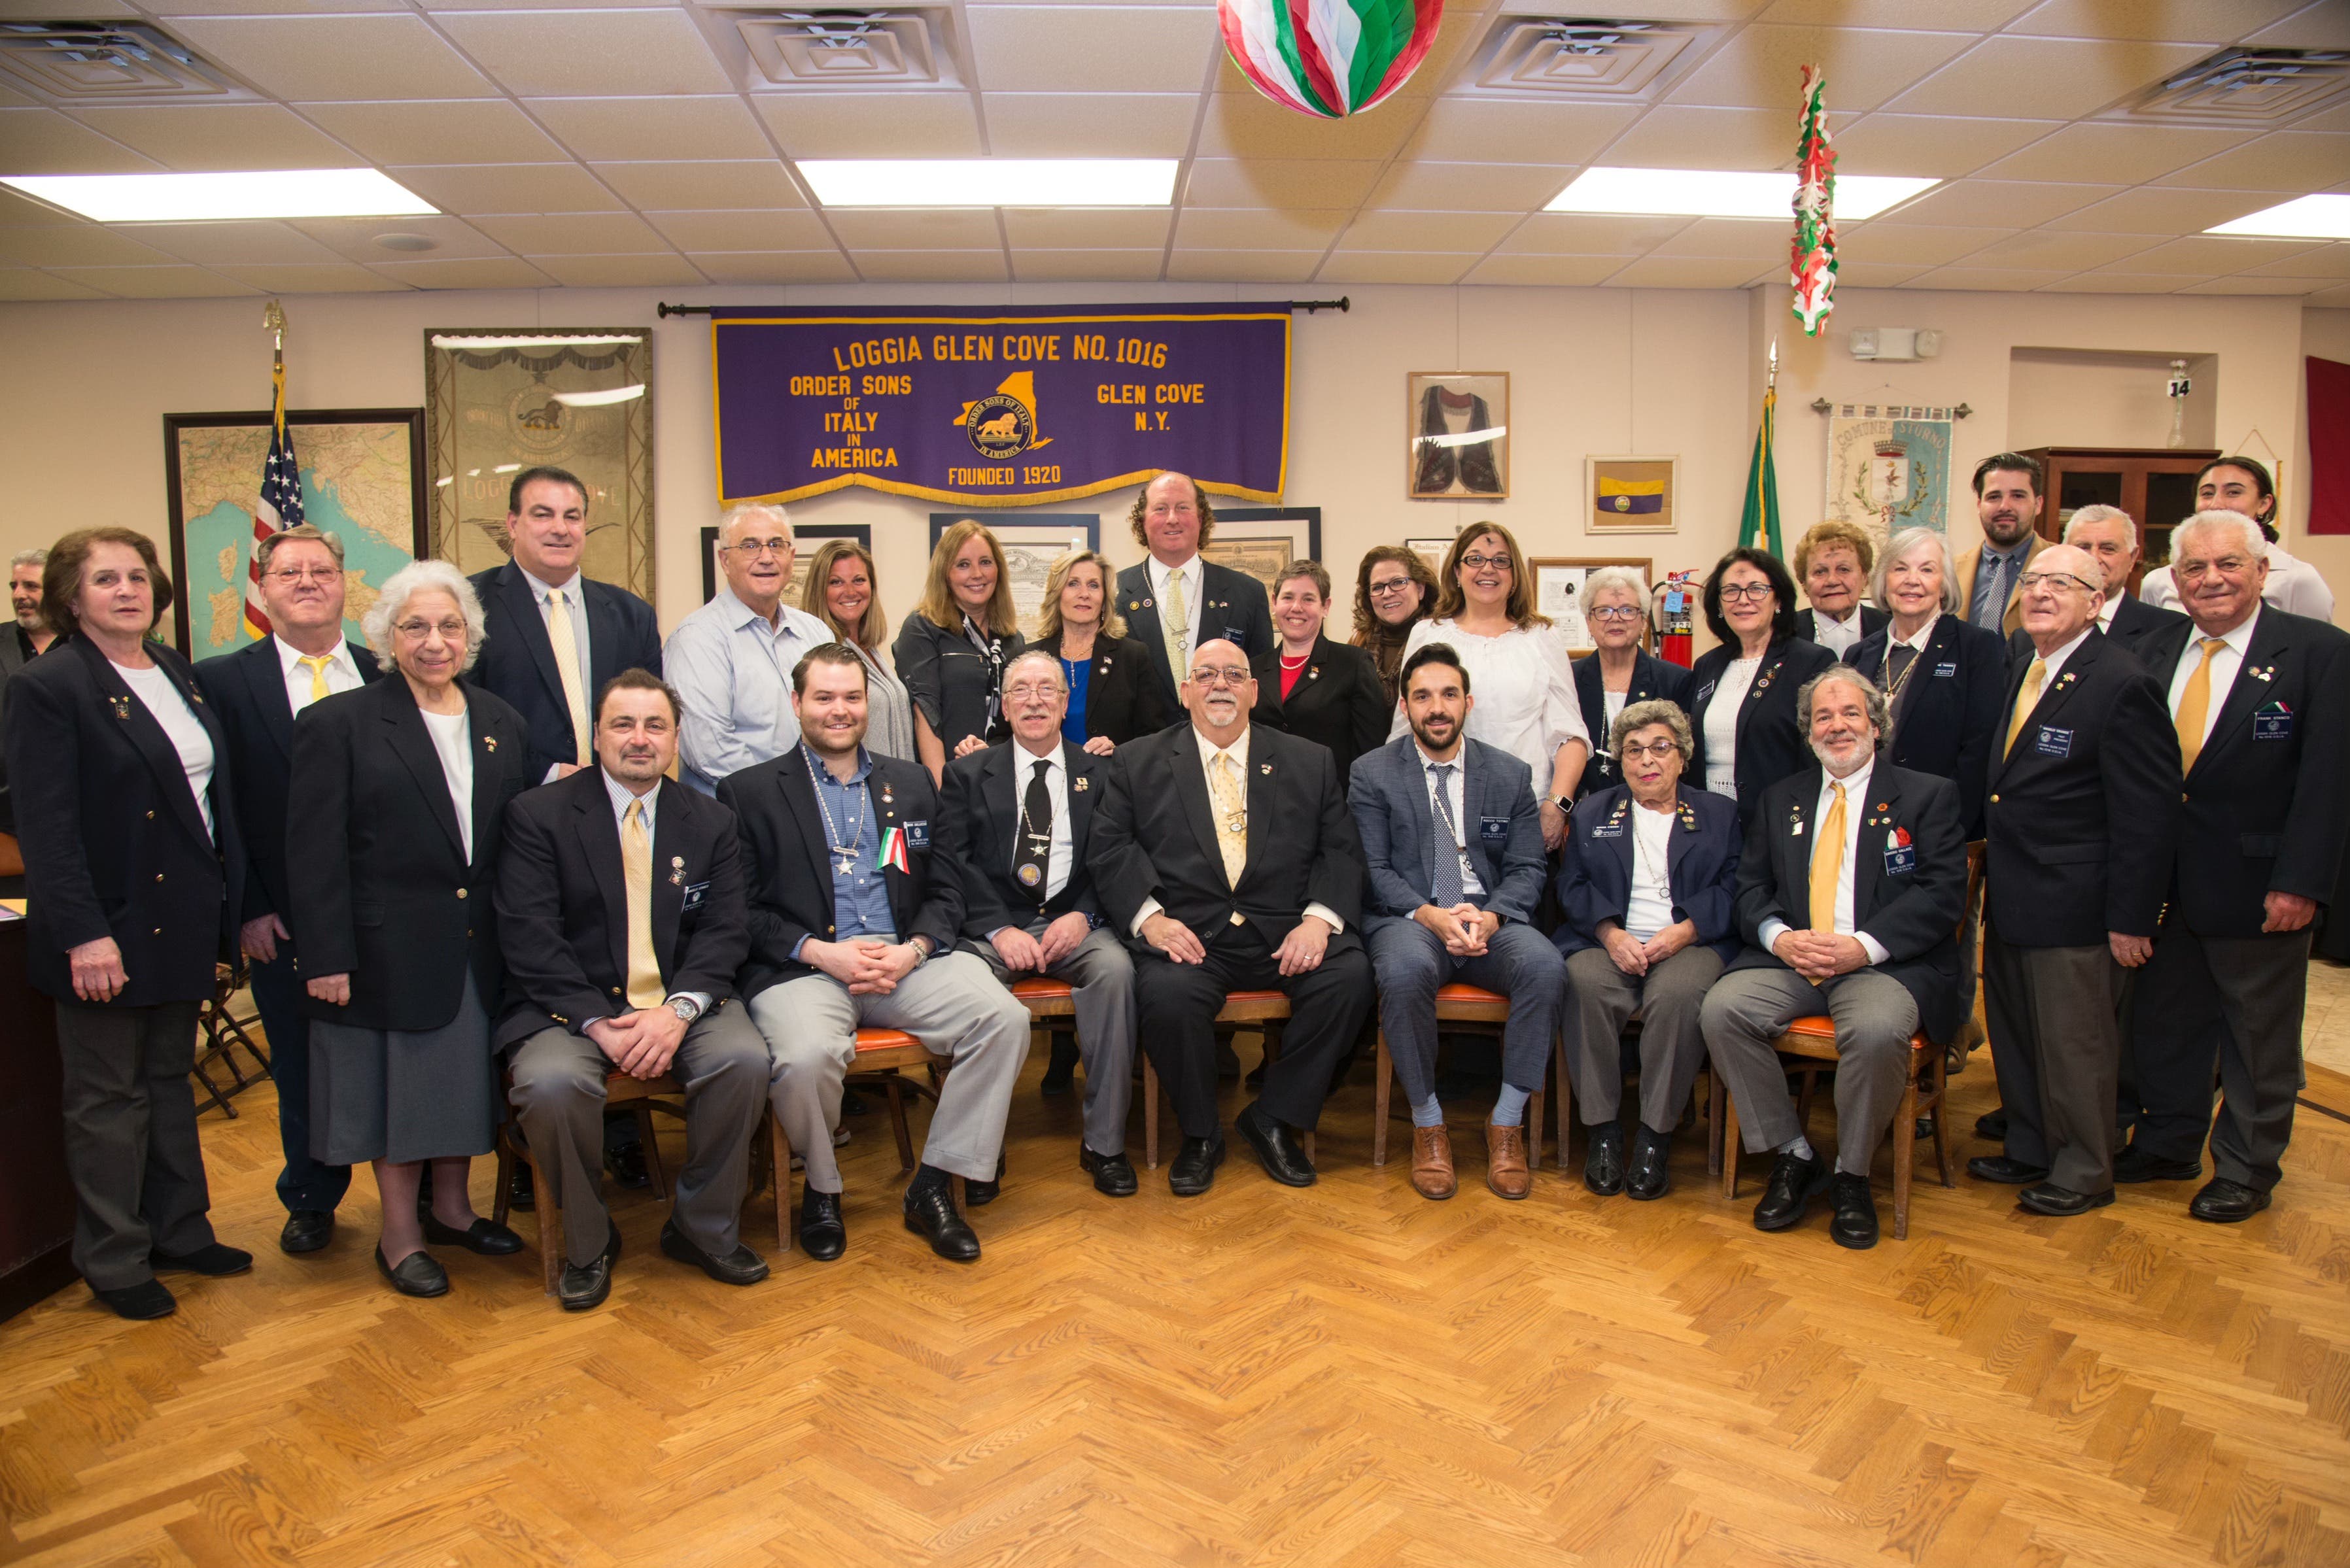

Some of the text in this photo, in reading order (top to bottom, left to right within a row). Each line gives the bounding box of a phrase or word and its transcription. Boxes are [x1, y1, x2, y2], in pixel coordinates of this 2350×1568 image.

[833, 334, 1168, 371] LOGGIA GLEN COVE NO. 1016
[790, 375, 912, 396] ORDER SONS
[1097, 383, 1205, 405] GLEN COVE
[2170, 380, 2189, 397] 14
[844, 397, 861, 411] OF
[969, 398, 1029, 427] ORDER SONS OF ITALY
[825, 411, 878, 432] ITALY
[1135, 411, 1171, 432] N.Y.
[847, 433, 861, 447] IN
[1836, 420, 1887, 446] COMUNE
[1899, 422, 1947, 449] STURNO
[811, 447, 899, 468] AMERICA
[980, 446, 1020, 458] IN AMERICA
[948, 465, 1062, 486] FOUNDED 1920
[585, 483, 621, 506] OVE
